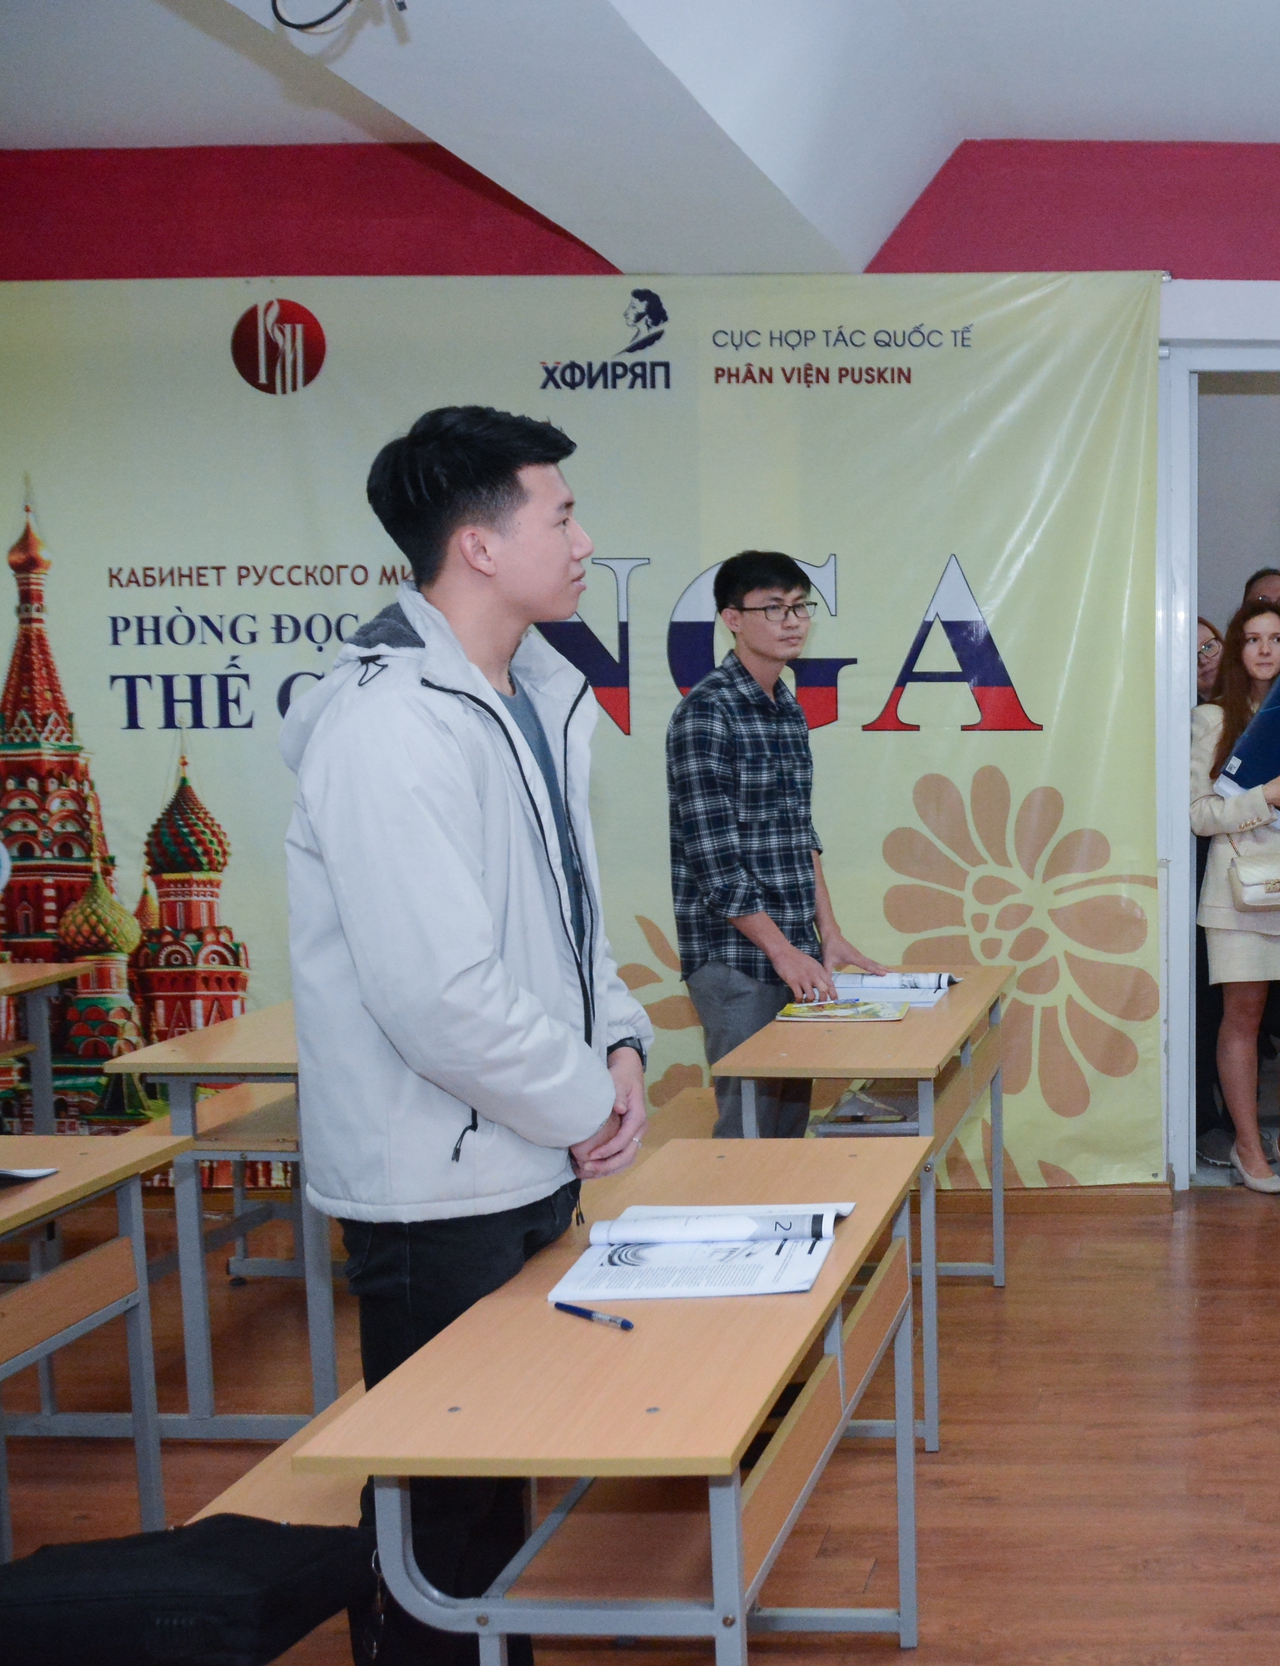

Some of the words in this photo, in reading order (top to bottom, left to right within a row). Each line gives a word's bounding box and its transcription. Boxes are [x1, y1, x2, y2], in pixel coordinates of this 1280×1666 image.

[711, 329, 761, 351] CỤC
[768, 328, 816, 351] HỢP
[822, 325, 866, 348] TÁC
[873, 323, 944, 348] QUỐC
[951, 323, 974, 348] TẾ
[714, 362, 773, 384] PHÂN
[780, 362, 830, 388] VIỆN
[838, 366, 912, 385] PUSKIN
[108, 565, 226, 588] КАБИНЕТ
[237, 563, 369, 587] РУССКОГО
[107, 606, 259, 646] PHÒNG
[271, 612, 360, 652] ĐỌC
[109, 654, 255, 730] THẾ
